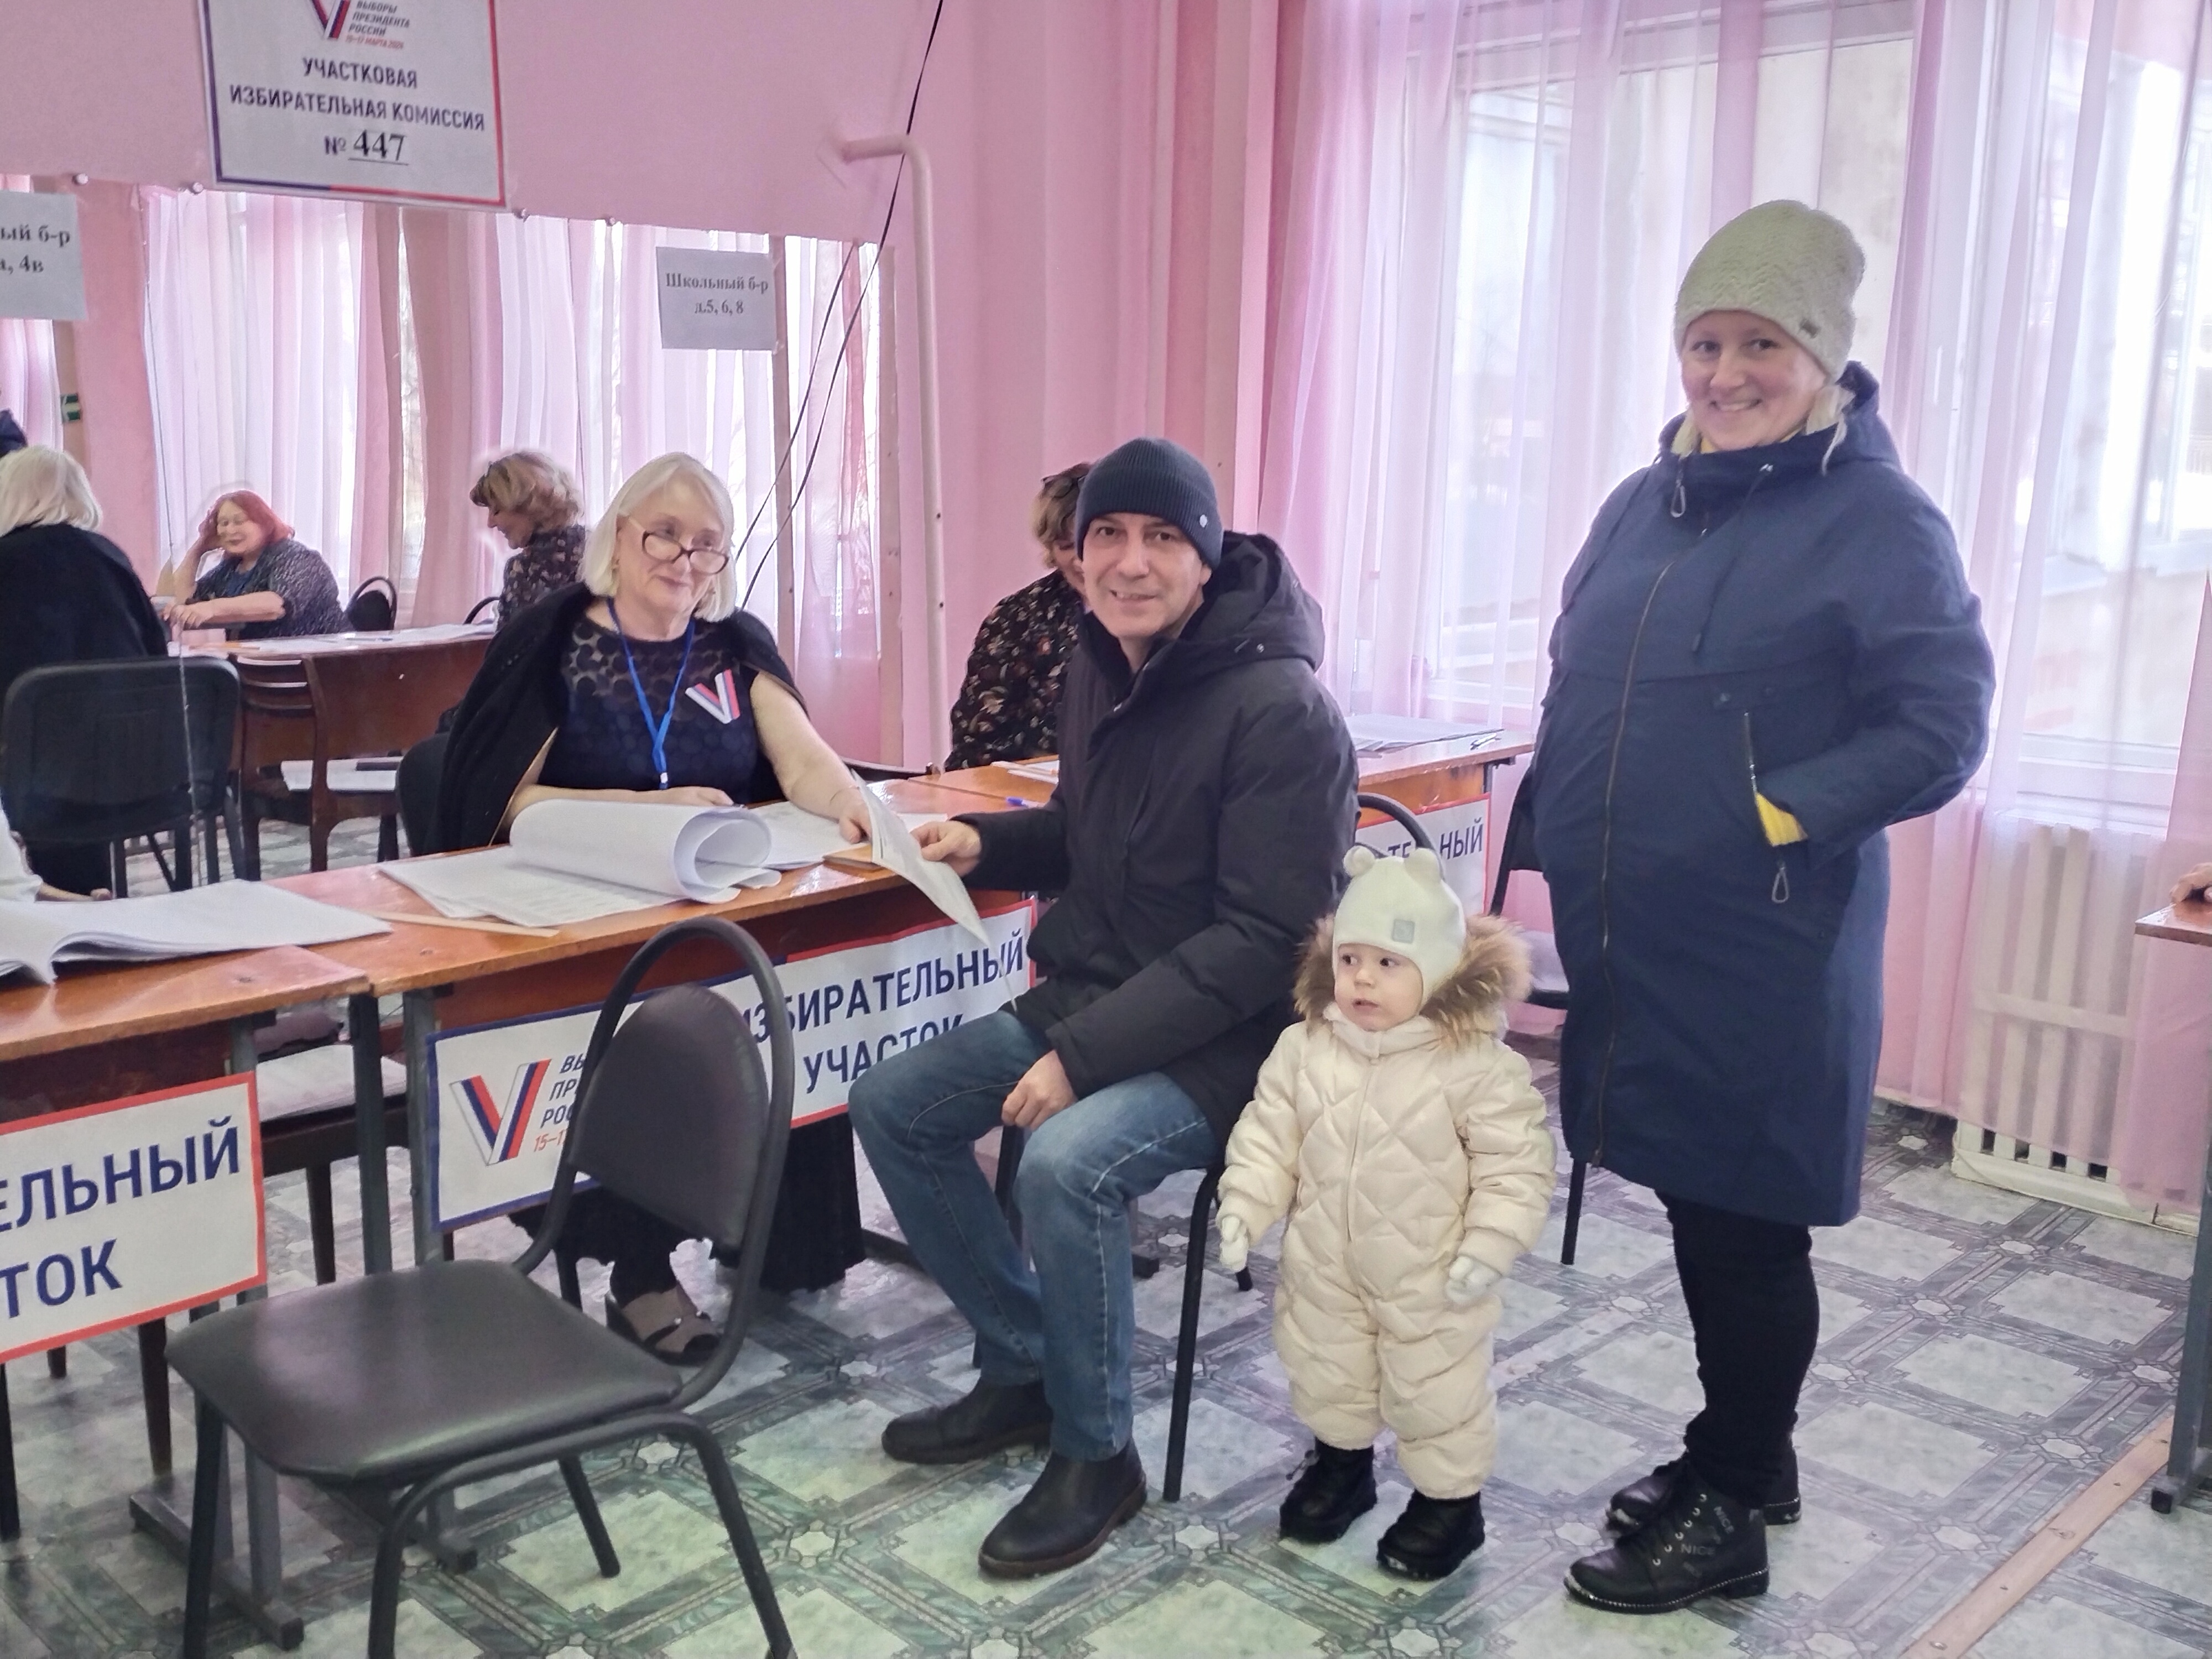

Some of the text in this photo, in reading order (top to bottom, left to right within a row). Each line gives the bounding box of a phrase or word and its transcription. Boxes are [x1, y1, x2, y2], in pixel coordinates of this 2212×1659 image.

[357, 1, 397, 13] ВЫБОРЫ
[349, 24, 386, 35] РОССИИ
[353, 12, 410, 27] ПРЕЗИДЕНТА
[302, 57, 417, 88] УЧАСТКОВАЯ
[229, 85, 486, 131] ИЗБИРАТЕЛЬНАЯ КОМИССИЯ
[324, 130, 407, 160] № 447
[38, 224, 70, 248] б-р
[19, 254, 44, 273] 4в
[666, 273, 769, 294] Школьный б-р
[722, 300, 733, 316] 6,
[736, 300, 744, 314] 8
[743, 928, 1023, 1043] ЗИРАТЕЛЬНЫЙ
[0, 1238, 123, 1319] ТОК
